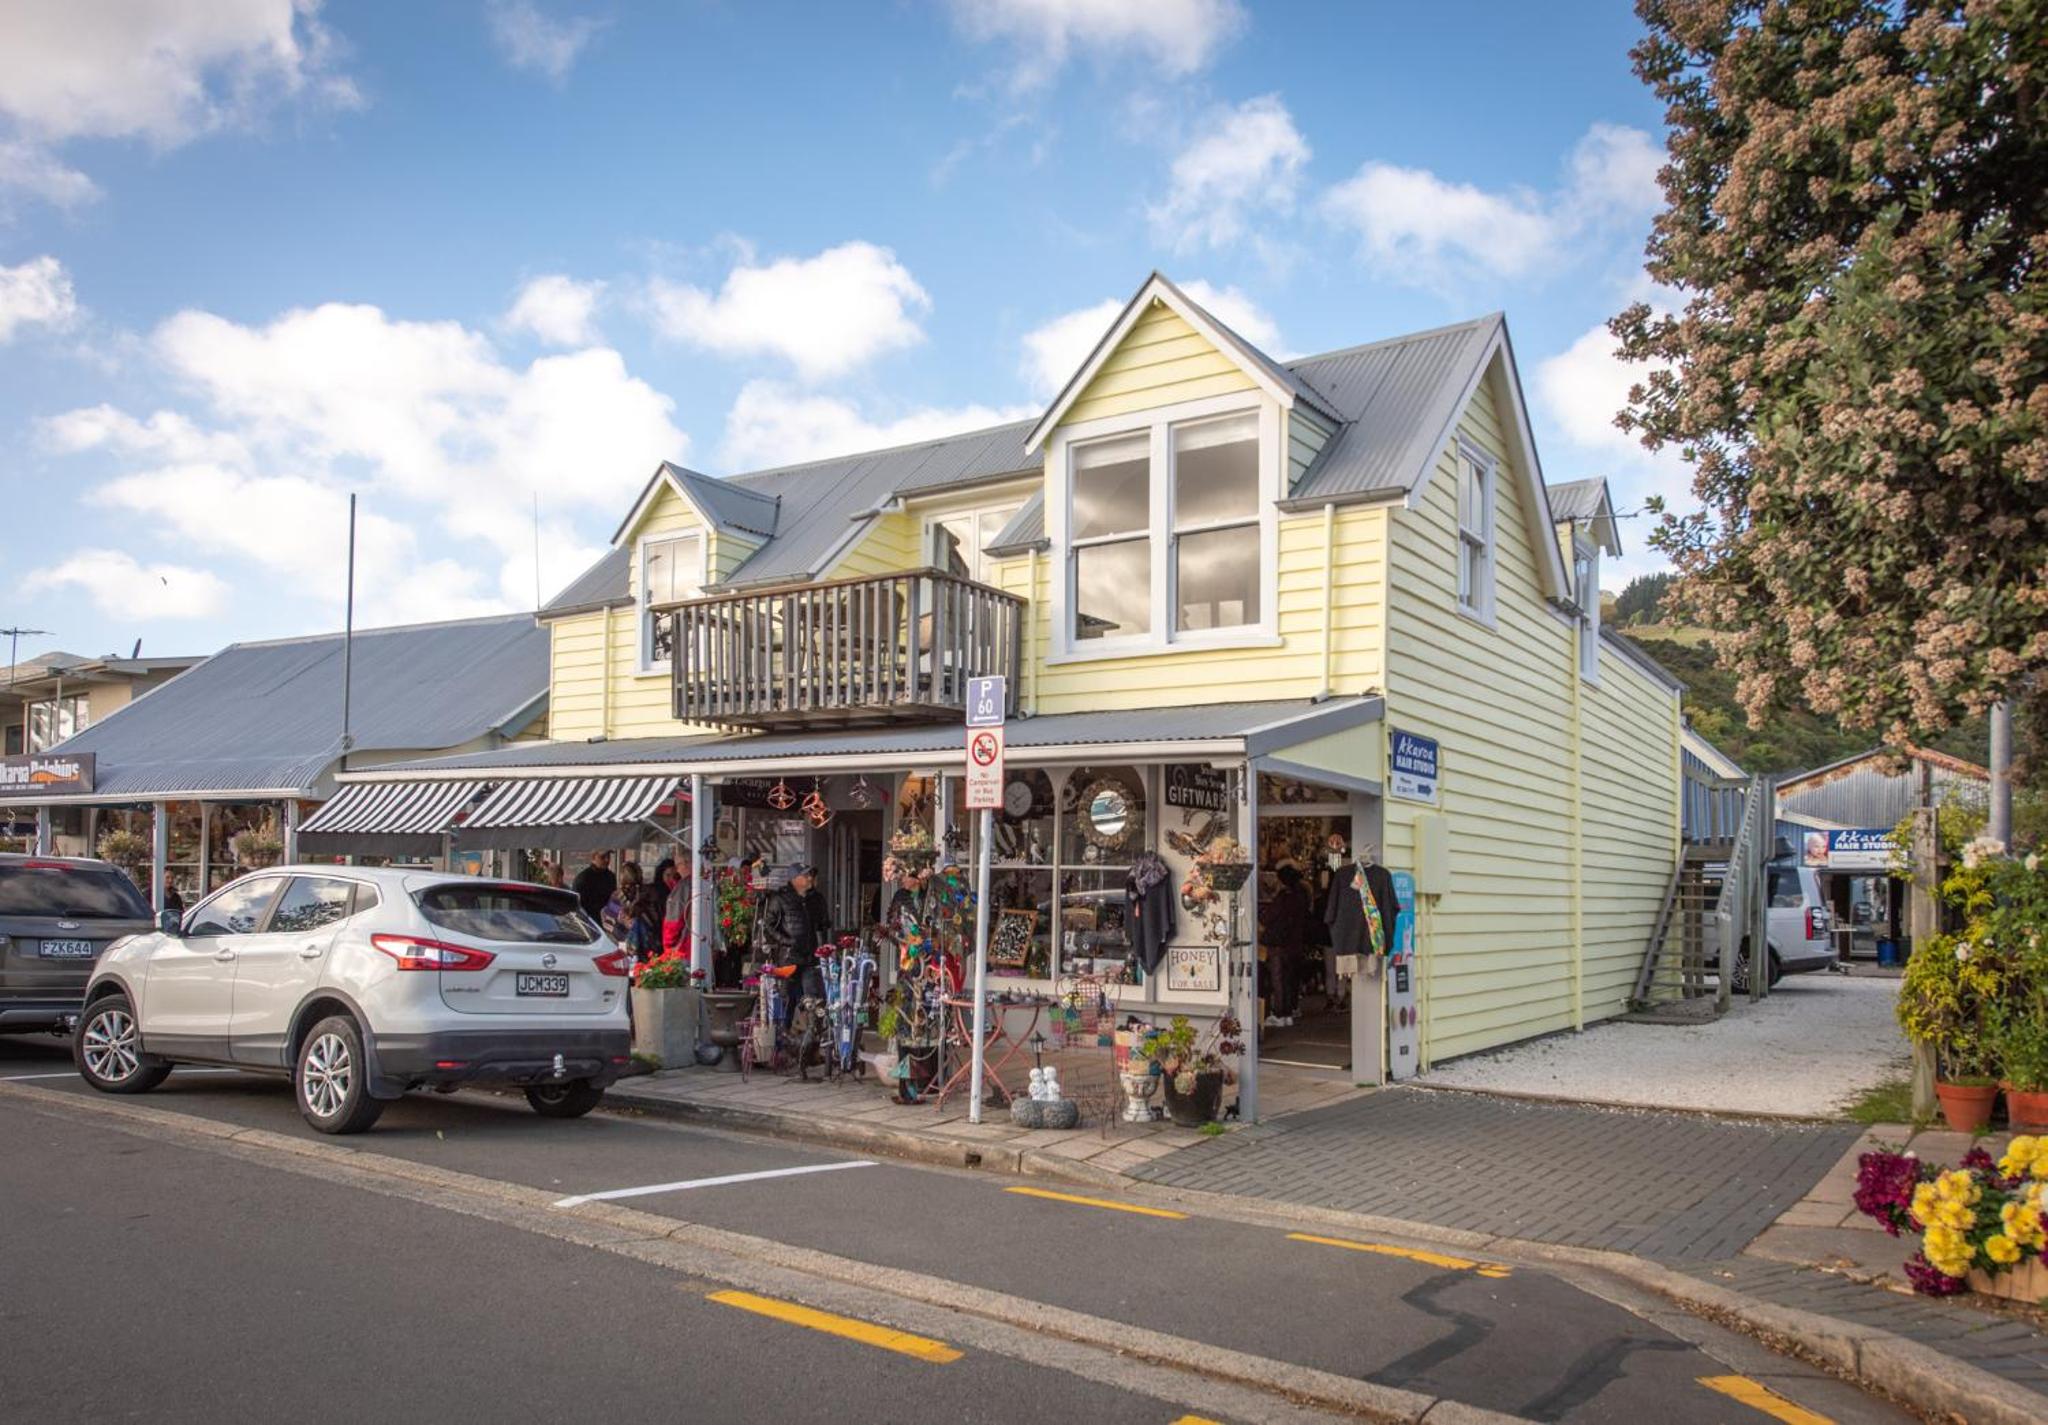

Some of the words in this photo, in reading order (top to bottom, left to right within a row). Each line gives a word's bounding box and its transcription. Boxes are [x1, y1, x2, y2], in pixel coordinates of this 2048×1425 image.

[980, 680, 992, 698] P
[977, 699, 993, 714] 60
[1397, 735, 1435, 762] Akaroa
[1396, 754, 1413, 769] HAIR
[1413, 759, 1435, 776] STUDIO
[1835, 831, 1889, 843] Akaro
[1834, 842, 1860, 850] HAIR
[42, 942, 90, 954] FZK644
[1171, 950, 1215, 965] HONEY
[519, 973, 567, 992] JCM339
